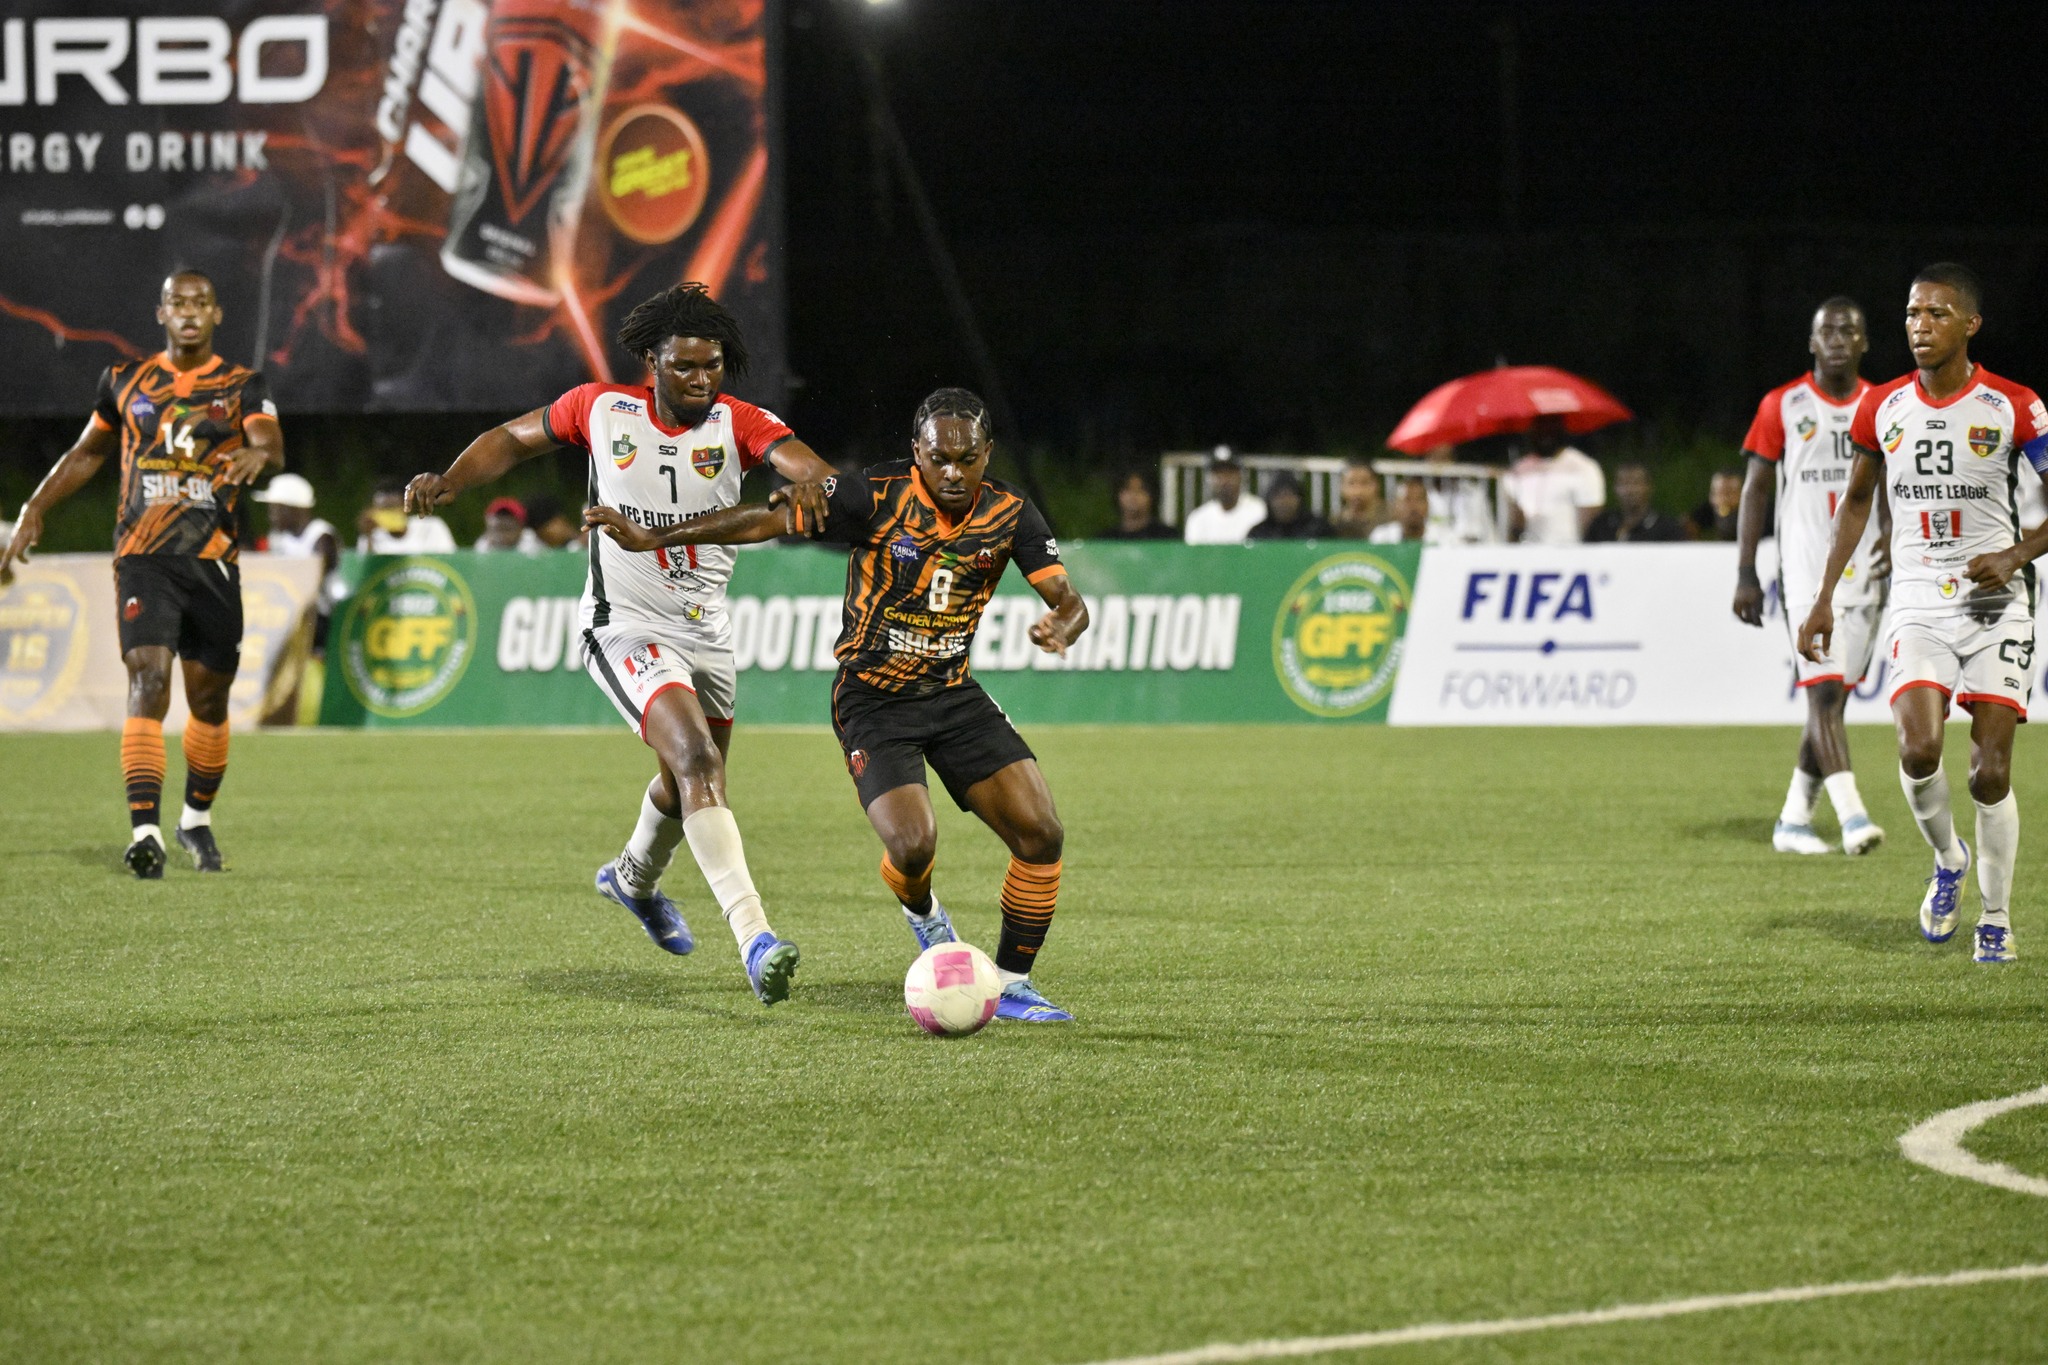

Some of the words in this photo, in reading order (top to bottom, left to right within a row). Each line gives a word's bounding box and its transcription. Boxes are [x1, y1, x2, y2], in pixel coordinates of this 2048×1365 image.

[0, 14, 330, 106] RBO
[0, 131, 103, 173] RGY
[125, 131, 268, 173] DRINK
[161, 422, 196, 458] 14
[1830, 430, 1854, 460] 10
[1915, 439, 1954, 476] 23
[659, 464, 678, 504] 7
[1912, 484, 1943, 500] ELITE
[1946, 484, 1990, 500] LEAGUE
[642, 509, 676, 528] ELITE
[928, 568, 954, 613] 8
[1462, 572, 1594, 621] FIFA
[365, 615, 454, 661] GFF
[970, 593, 1242, 672] EDERATION
[1300, 612, 1392, 659] GFF
[1439, 670, 1638, 709] FORWARD
